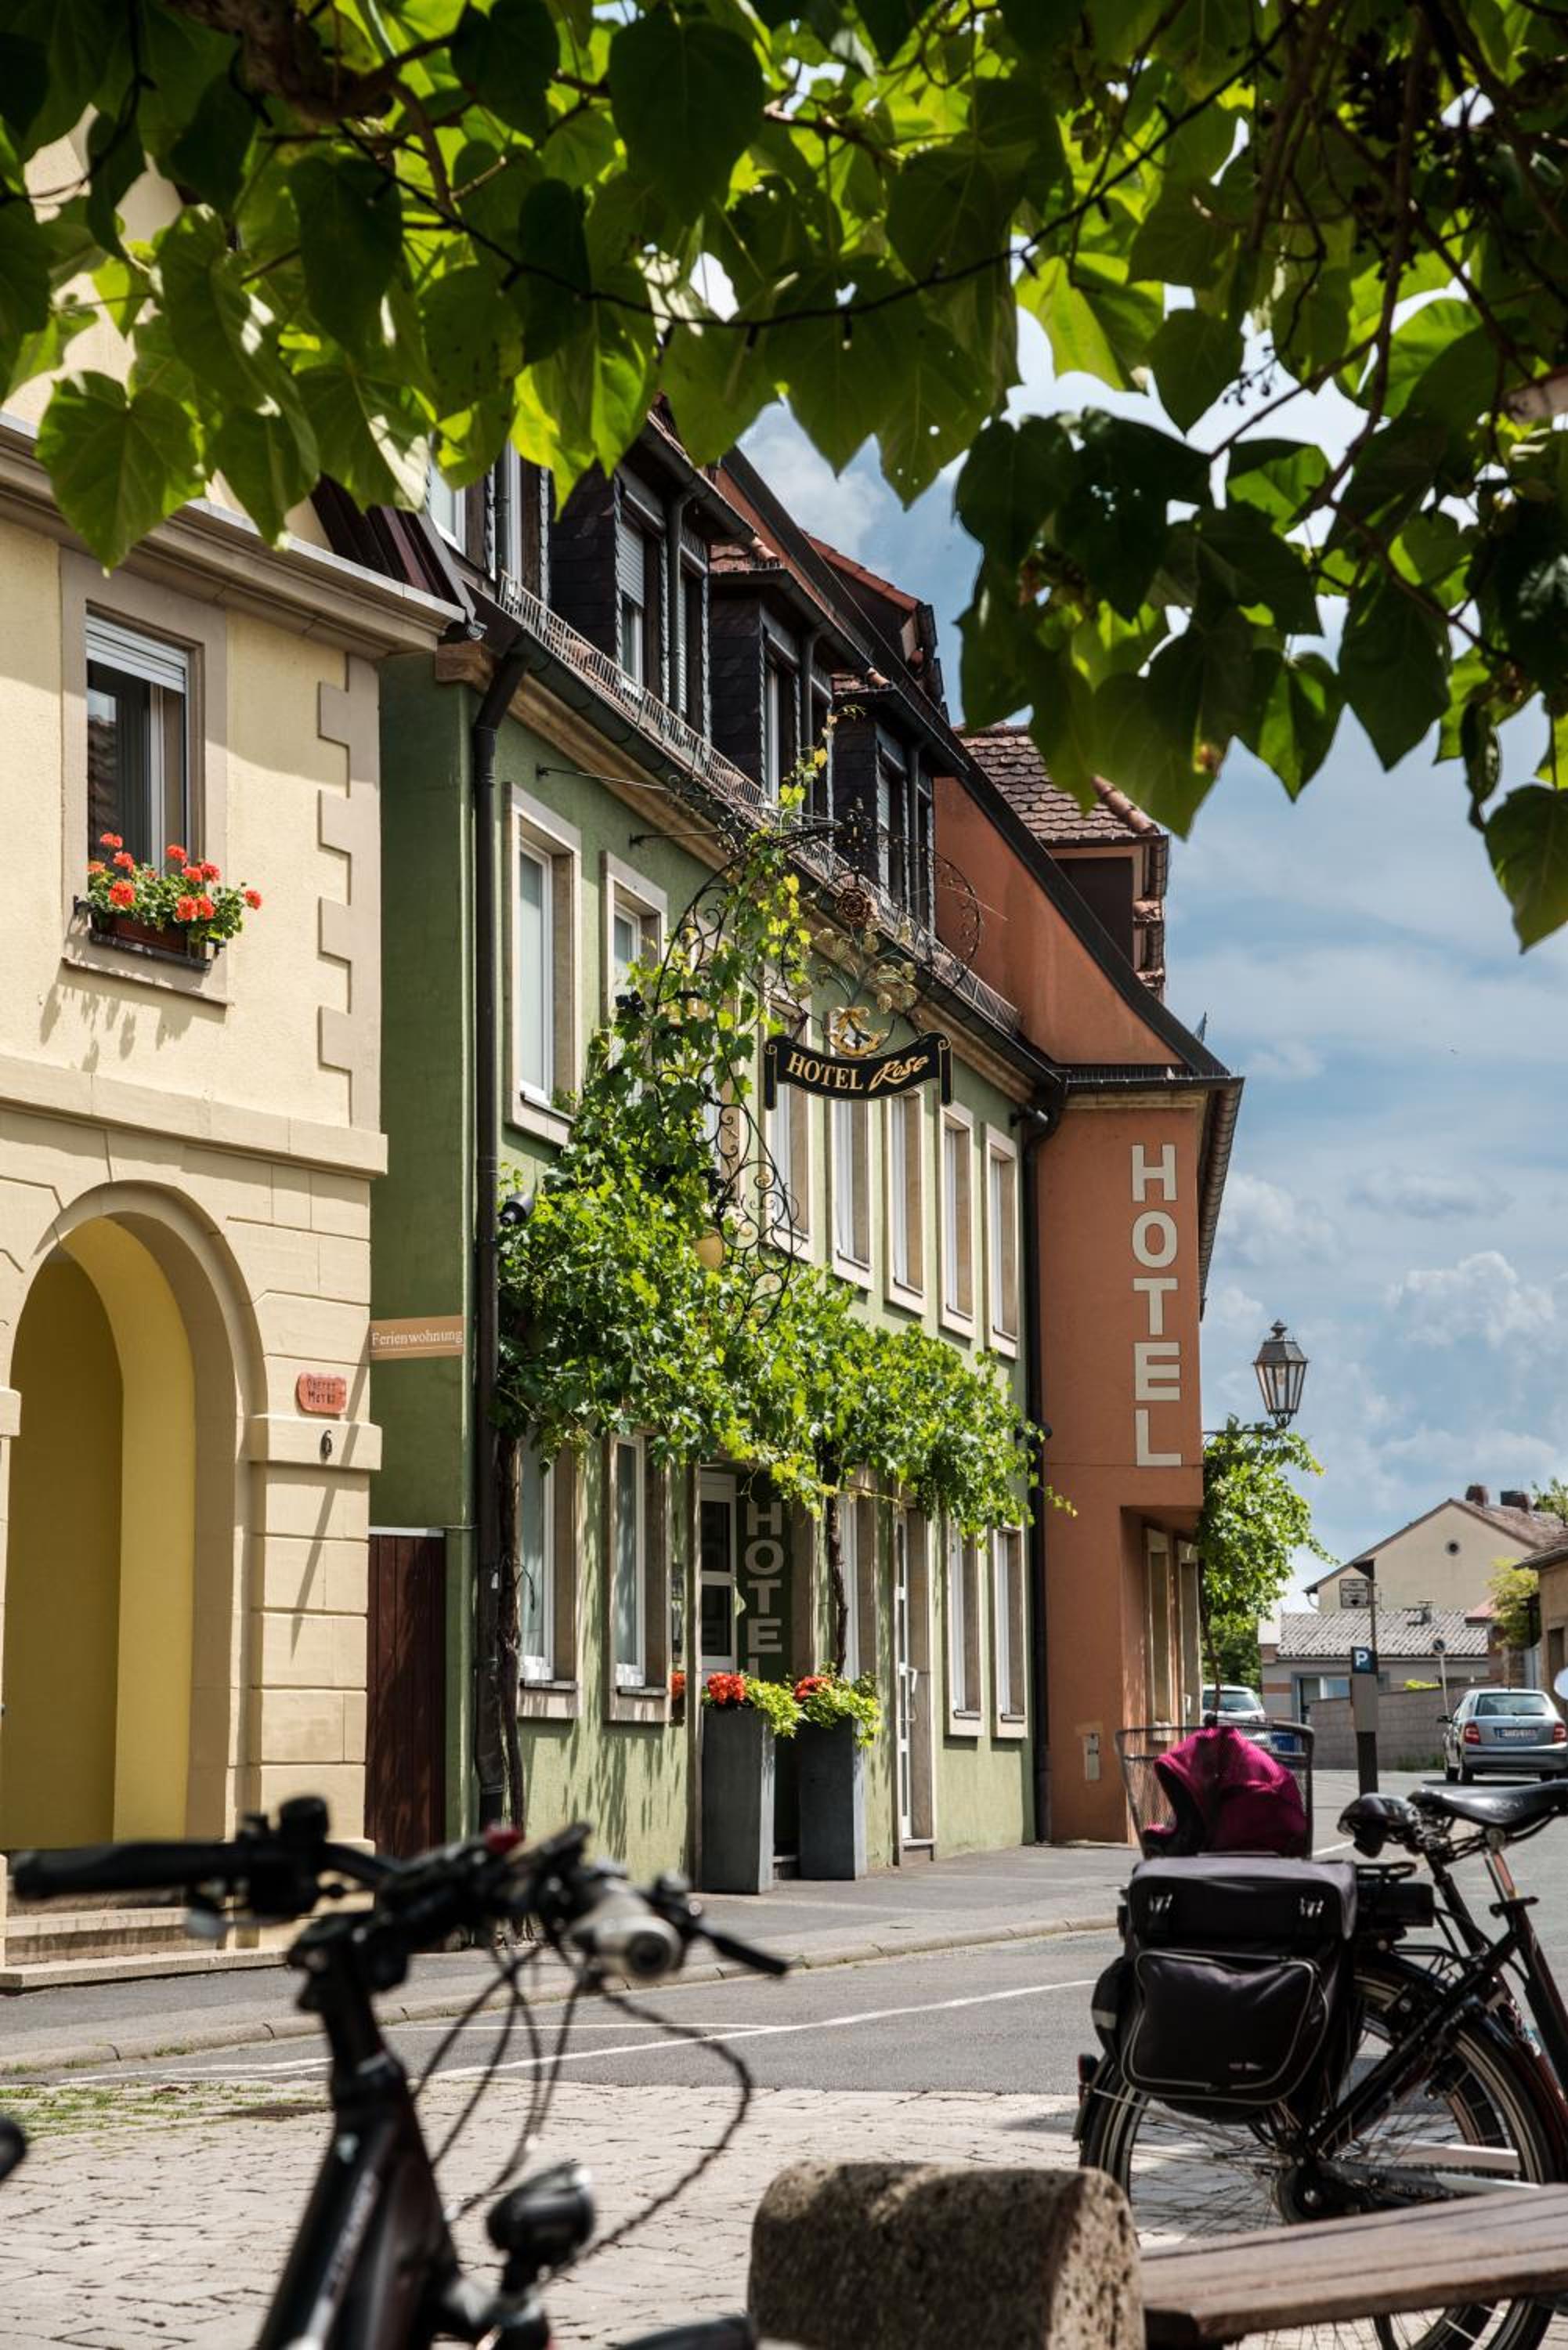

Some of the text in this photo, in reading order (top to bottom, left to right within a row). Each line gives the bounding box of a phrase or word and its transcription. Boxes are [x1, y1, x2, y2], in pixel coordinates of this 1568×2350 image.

[786, 1052, 930, 1091] HOTEL Rose
[1131, 1144, 1182, 1466] HOTEL
[372, 1329, 463, 1345] Ferienwohnung
[320, 1430, 332, 1458] 6
[1355, 1650, 1368, 1666] P
